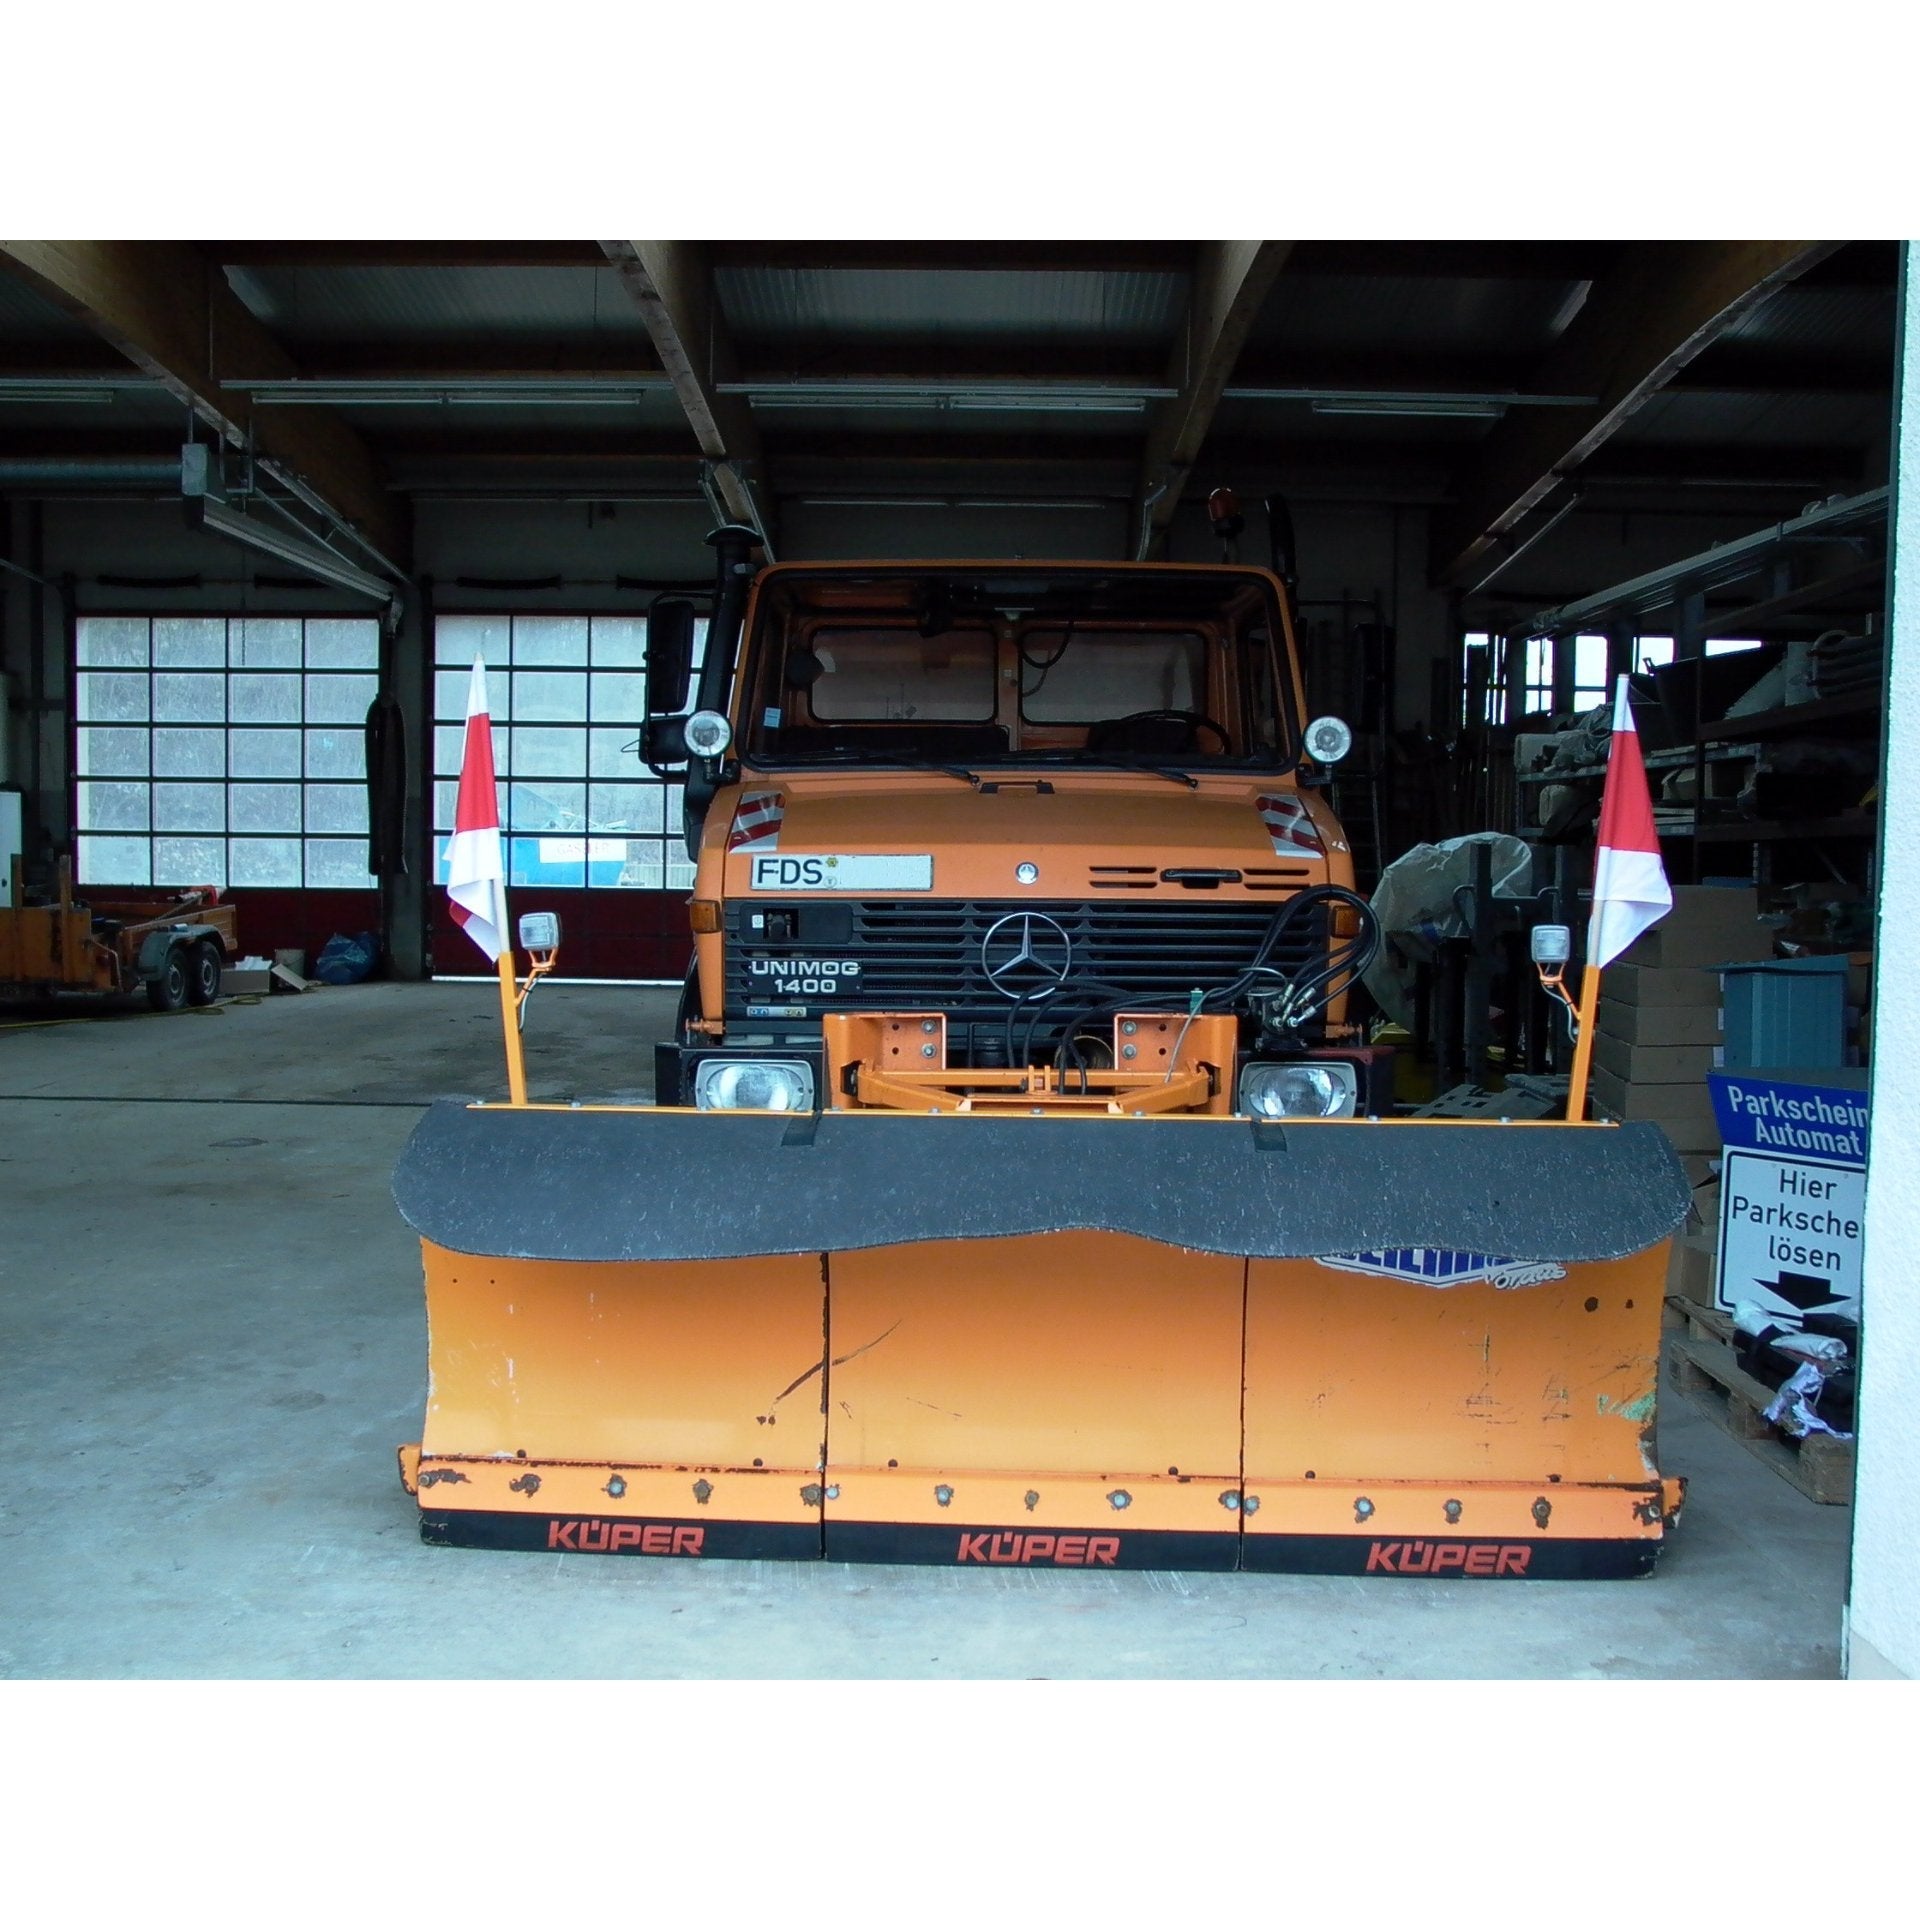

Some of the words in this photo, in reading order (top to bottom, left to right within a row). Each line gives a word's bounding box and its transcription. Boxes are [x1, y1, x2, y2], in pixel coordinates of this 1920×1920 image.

[757, 858, 823, 885] FDS
[751, 961, 860, 976] UNIMOG
[774, 979, 836, 993] 1400
[1755, 1118, 1863, 1156] Automat
[1780, 1169, 1838, 1199] Hier
[1769, 1235, 1841, 1271] lösen
[548, 1519, 705, 1555] KÜPER
[957, 1531, 1120, 1565] KÜPER
[1366, 1541, 1532, 1575] KÜPER
